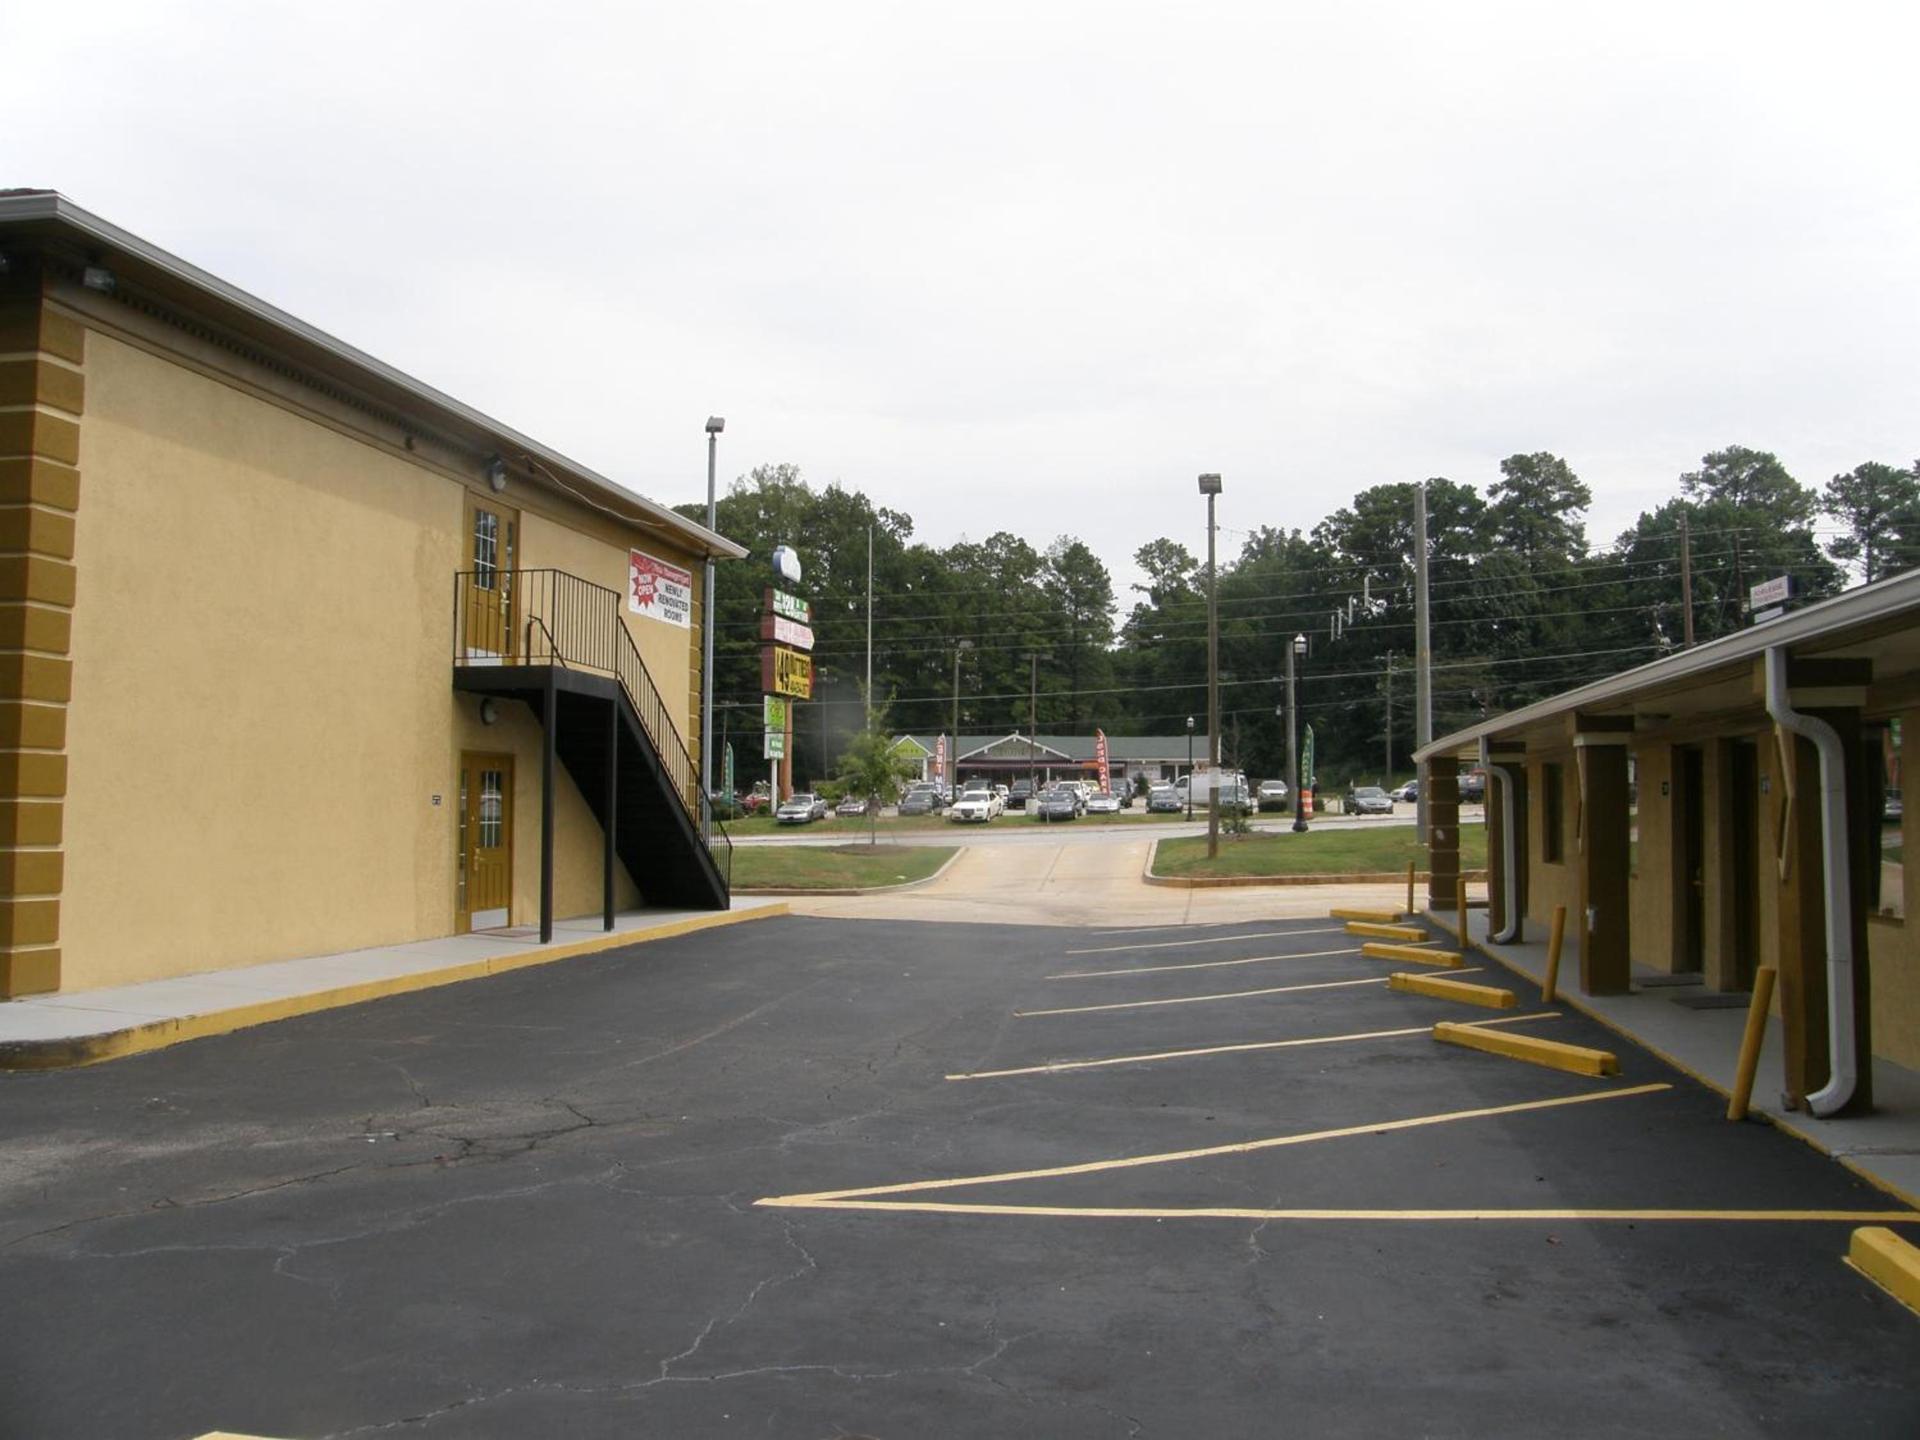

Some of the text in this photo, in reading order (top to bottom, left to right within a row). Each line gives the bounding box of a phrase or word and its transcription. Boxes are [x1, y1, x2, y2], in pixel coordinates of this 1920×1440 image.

[637, 584, 654, 596] OPEN
[664, 583, 684, 598] NEWLY
[658, 594, 689, 612] RENOVATED
[663, 607, 683, 623] ROOMS
